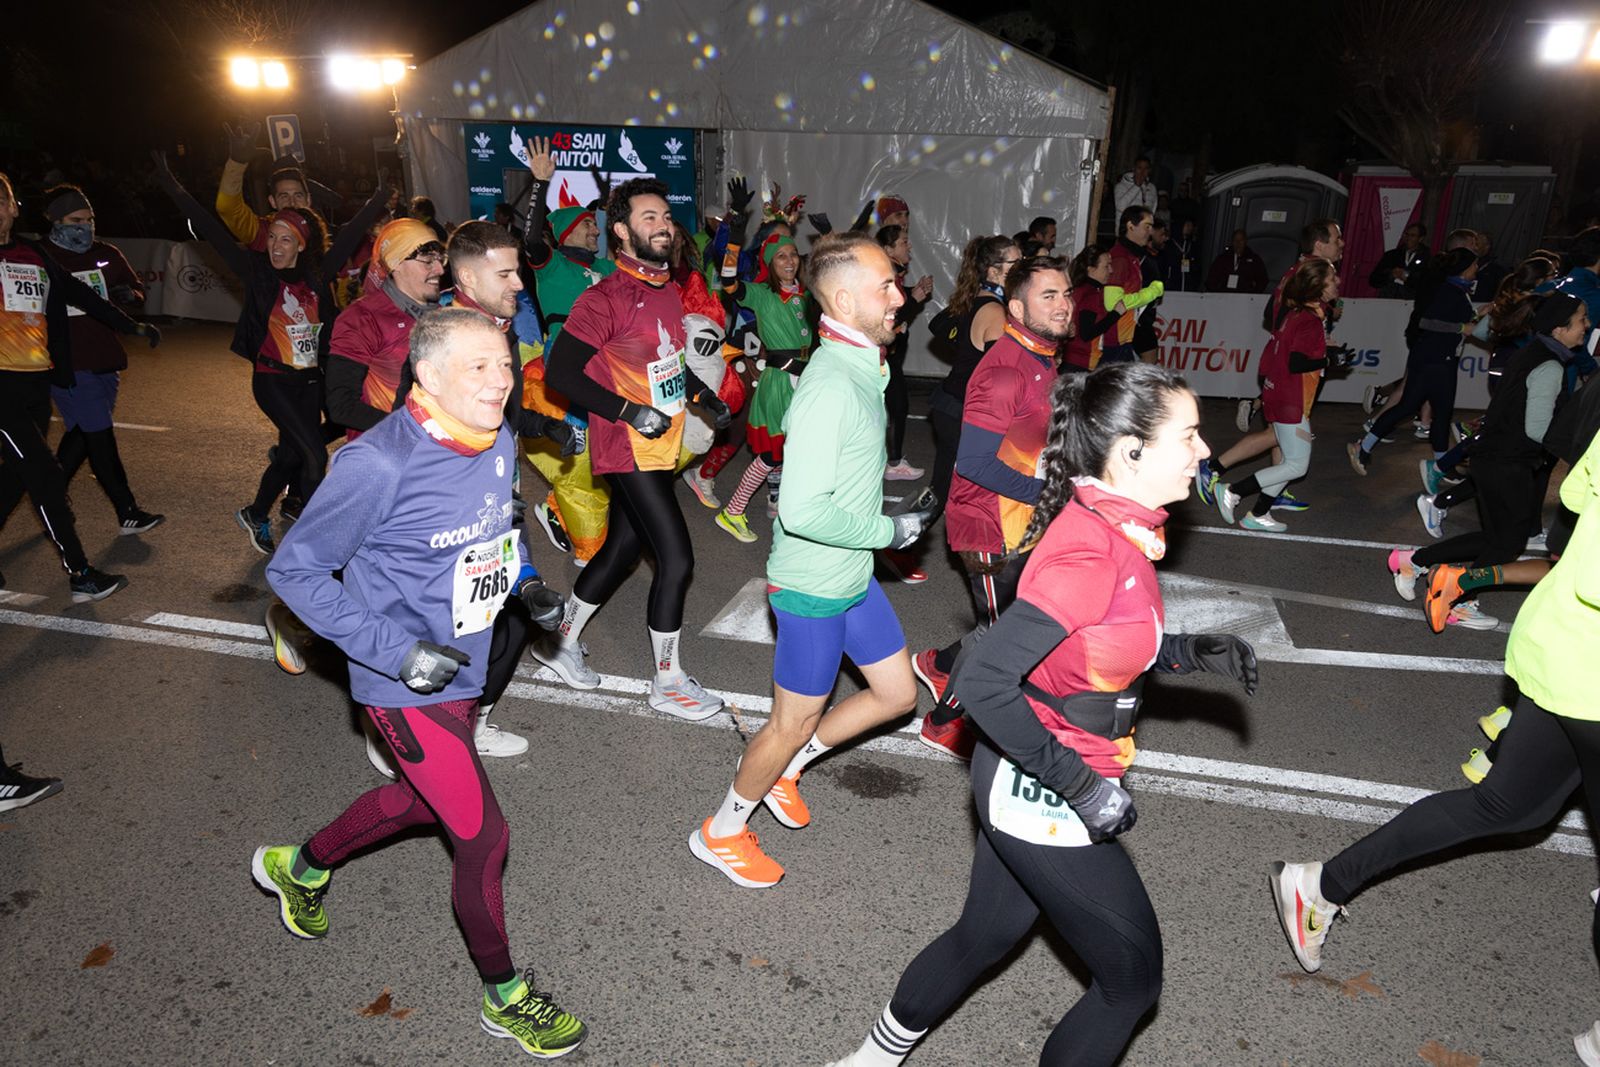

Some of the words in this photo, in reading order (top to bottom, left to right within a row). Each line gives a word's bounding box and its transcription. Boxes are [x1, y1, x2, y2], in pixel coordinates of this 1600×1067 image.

[275, 120, 295, 158] P
[551, 132, 571, 150] 43
[572, 133, 606, 149] SAN
[549, 149, 604, 167] ANTÓN
[626, 153, 638, 165] 43
[15, 280, 45, 296] 2616
[1152, 317, 1208, 343] SAN
[465, 564, 483, 576] SAN
[469, 566, 509, 603] 7686
[1041, 808, 1069, 820] LAURA
